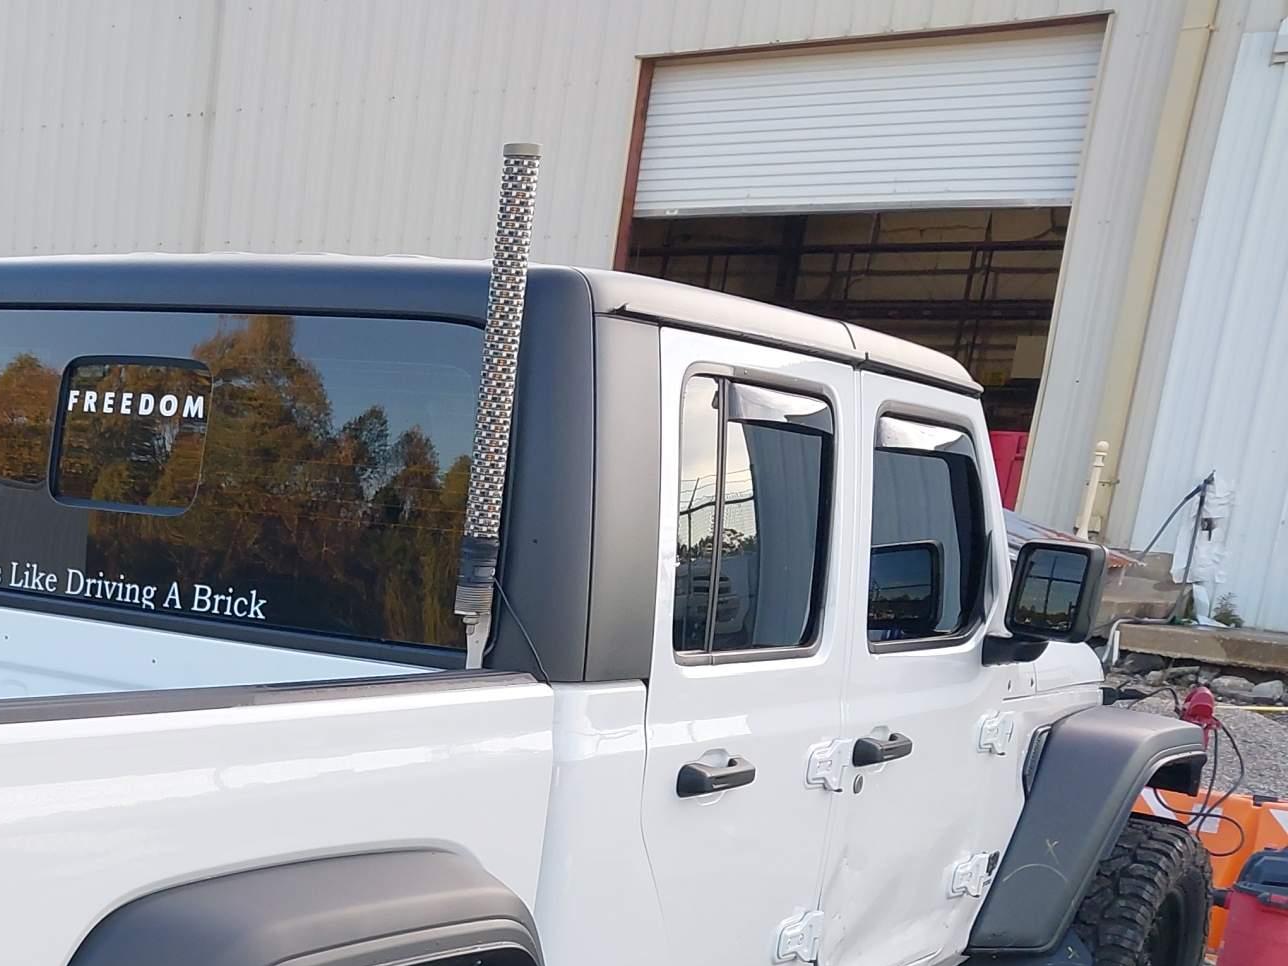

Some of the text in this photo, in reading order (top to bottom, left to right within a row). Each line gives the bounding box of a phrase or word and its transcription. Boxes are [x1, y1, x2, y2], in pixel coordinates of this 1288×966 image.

[67, 390, 204, 418] FREEDOM
[9, 562, 58, 592] Like
[65, 568, 157, 610] Driving
[162, 581, 182, 609] A
[191, 584, 267, 619] Brick
